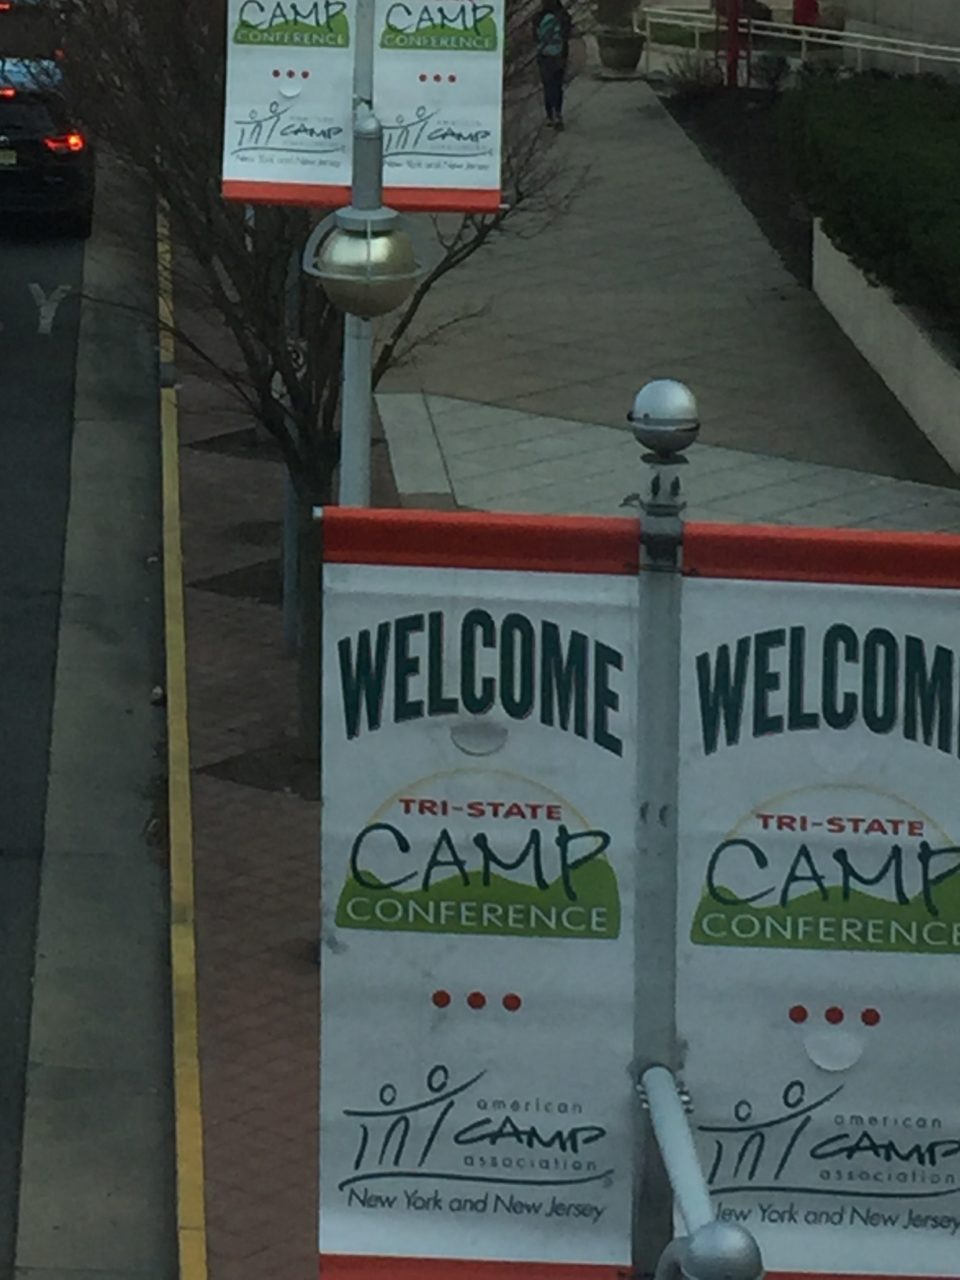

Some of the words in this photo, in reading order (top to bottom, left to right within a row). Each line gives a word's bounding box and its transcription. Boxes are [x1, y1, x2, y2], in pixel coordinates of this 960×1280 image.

[239, 0, 346, 33] CAMP
[385, 2, 494, 37] CAMP
[236, 30, 345, 45] CONFERENCE
[280, 123, 343, 139] CAMP
[427, 127, 491, 143] CAMP
[337, 607, 624, 759] WELCOME
[696, 623, 960, 760] WELCOM
[399, 798, 563, 821] TRI-STATE
[756, 813, 924, 837] TRI-STATE
[350, 822, 611, 902] CAMP
[706, 838, 960, 917] CAMP
[346, 896, 608, 933] CONFERENCE
[477, 1097, 583, 1115] american
[834, 1113, 943, 1129] american
[454, 1115, 607, 1154] CAMP
[809, 1130, 960, 1167] CAMP
[464, 1153, 597, 1171] association
[819, 1169, 955, 1185] association
[347, 1187, 396, 1209] New
[403, 1189, 442, 1213] York
[449, 1192, 488, 1214] and
[493, 1194, 543, 1216] New
[545, 1196, 605, 1223] Jersey
[758, 1202, 799, 1225] York
[804, 1203, 844, 1226] and
[849, 1206, 899, 1228] New
[902, 1208, 960, 1236] Jersey
